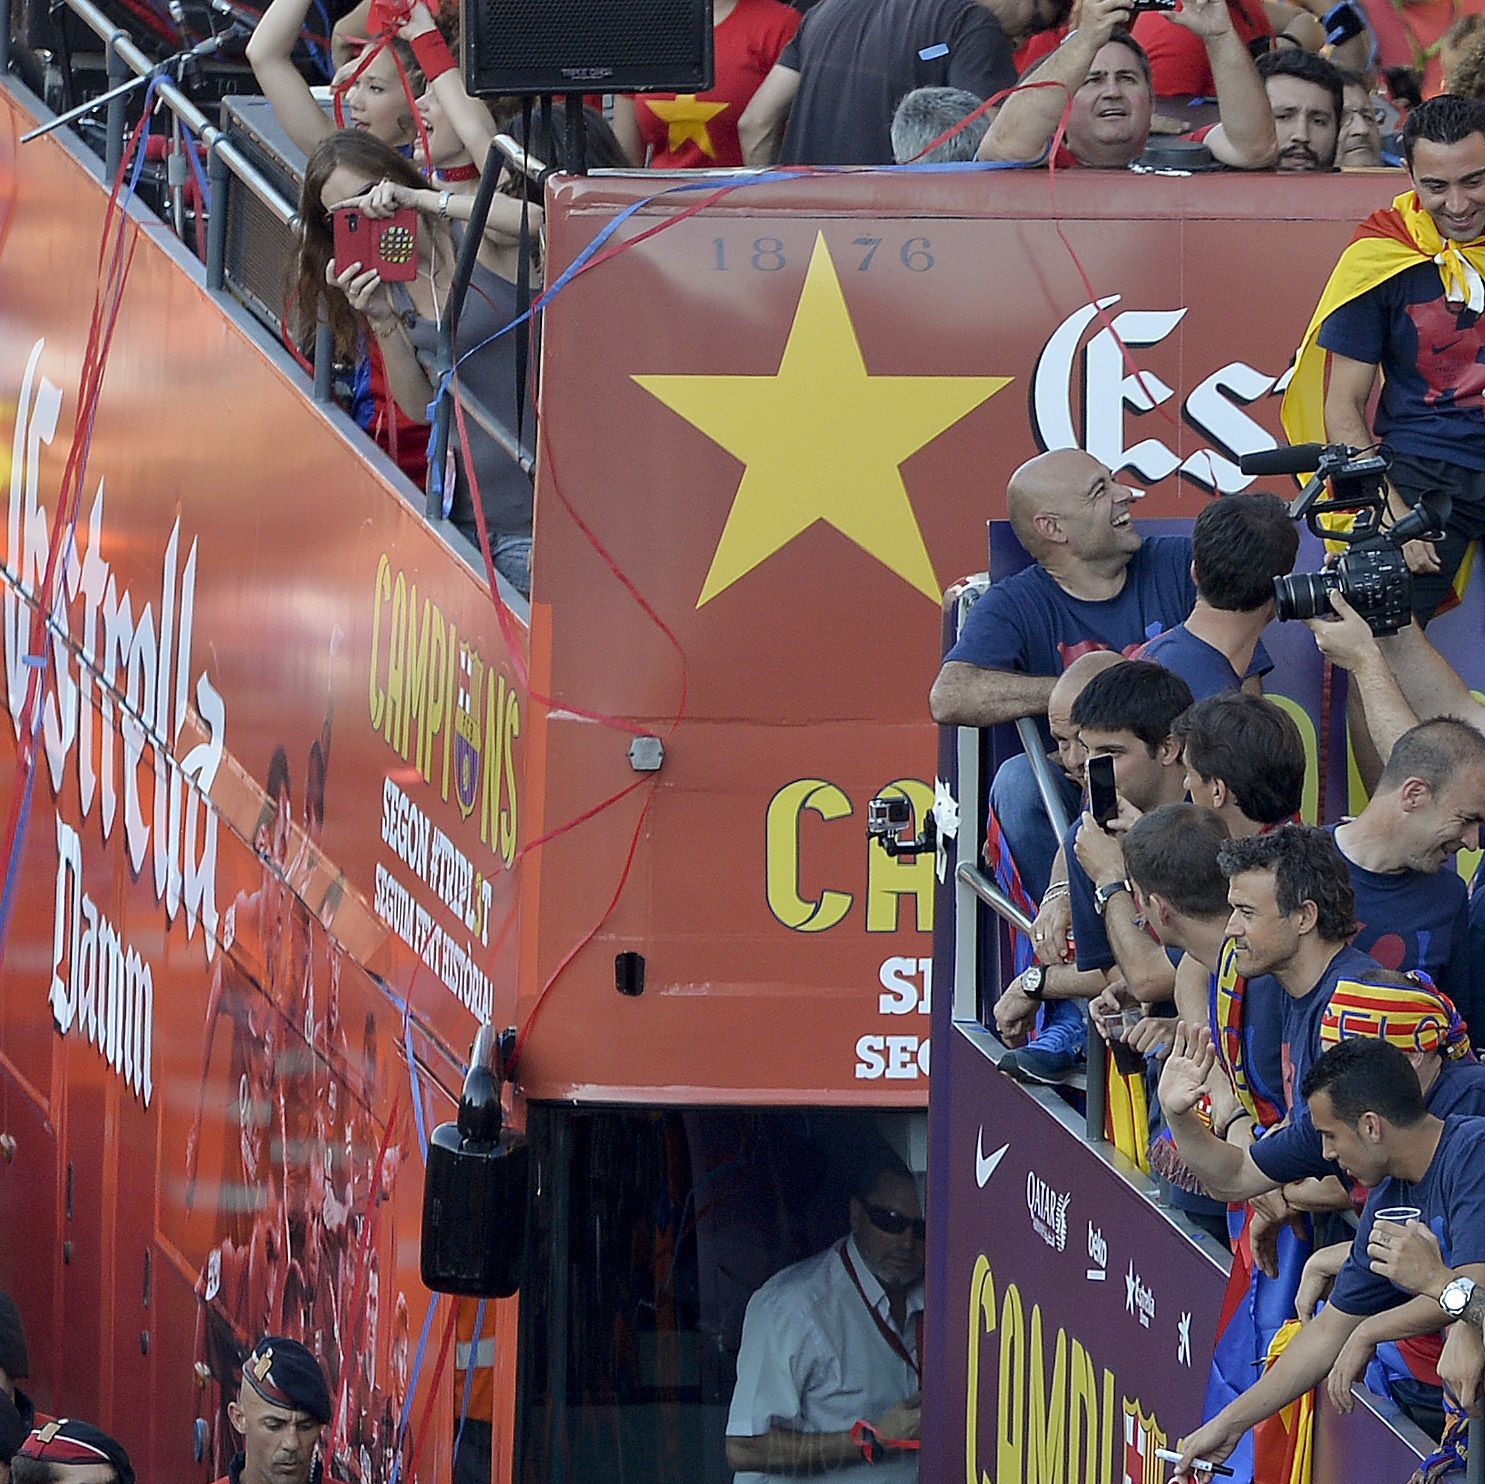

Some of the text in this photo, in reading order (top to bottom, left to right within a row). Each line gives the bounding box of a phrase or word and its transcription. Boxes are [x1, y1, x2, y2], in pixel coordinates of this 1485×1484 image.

[369, 552, 521, 871] CAMPINS
[49, 808, 153, 1109] Damm
[1026, 1170, 1056, 1230] QATAR
